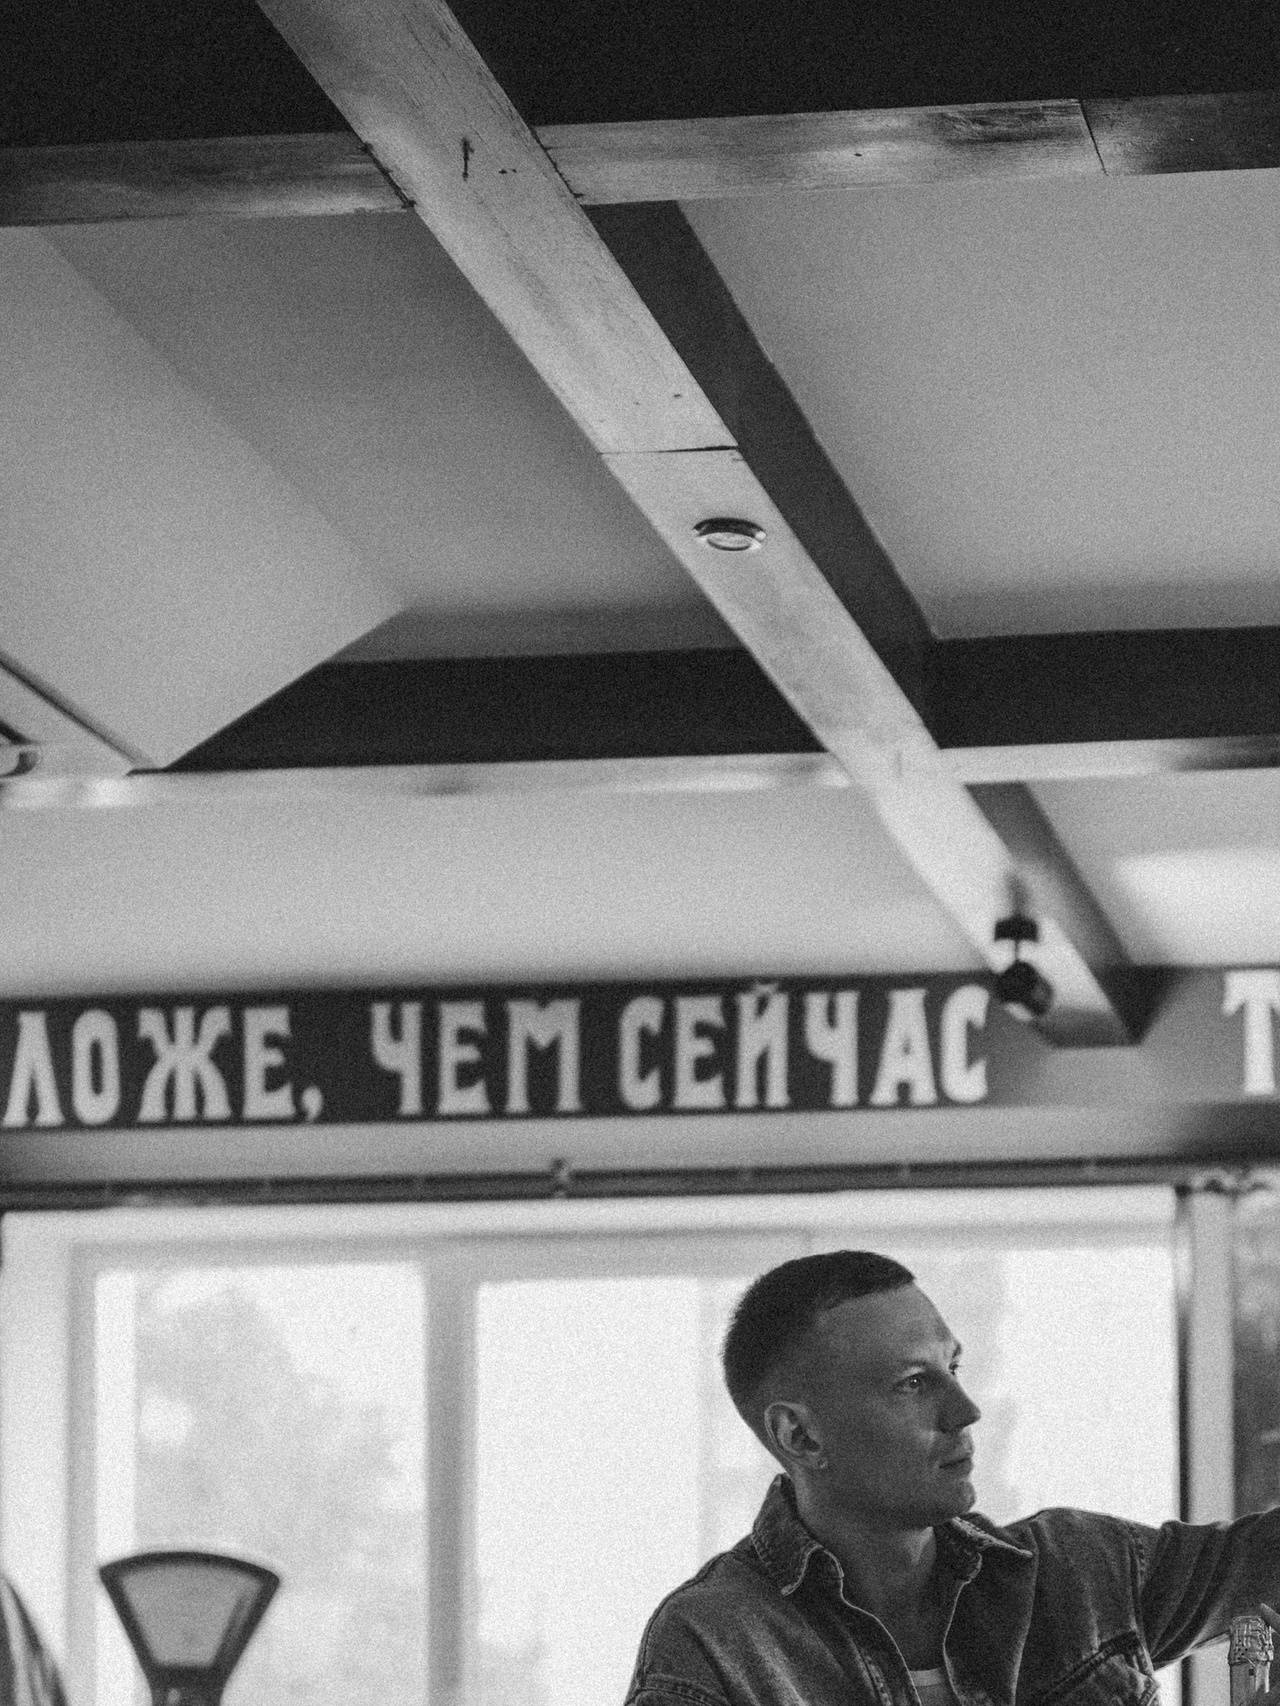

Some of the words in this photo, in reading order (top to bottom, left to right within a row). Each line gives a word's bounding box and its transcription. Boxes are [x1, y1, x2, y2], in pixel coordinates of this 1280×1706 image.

[1, 1007, 323, 1127] ЛОЖЕ,
[370, 1000, 583, 1115] ЧЕМ
[618, 983, 991, 1110] СЕЙЧАС
